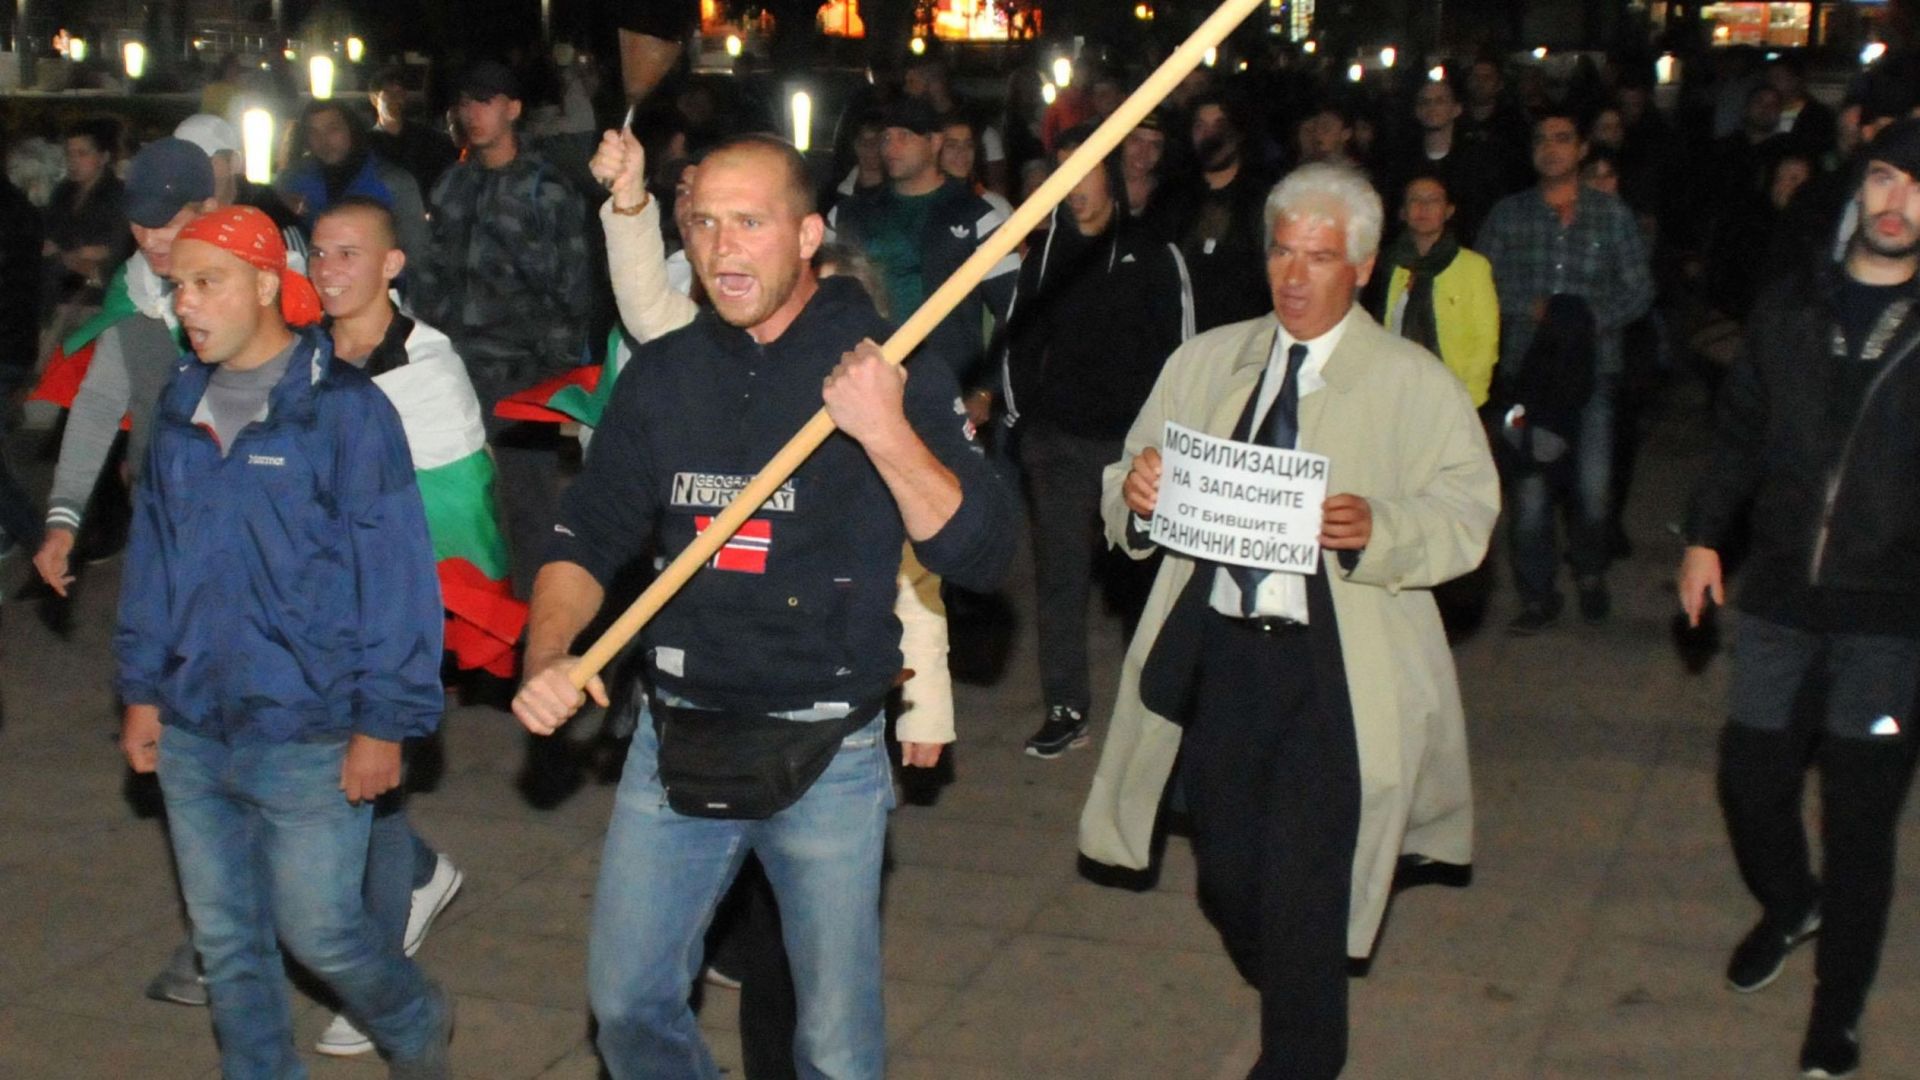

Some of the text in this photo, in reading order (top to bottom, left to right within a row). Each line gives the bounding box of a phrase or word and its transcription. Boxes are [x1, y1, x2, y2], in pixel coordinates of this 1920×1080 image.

[1166, 428, 1325, 480] МОБИЛИЗАЦИЯ
[674, 475, 790, 509] NORAY
[1173, 468, 1304, 508] НА ЗАПАСНИТЕ
[1179, 504, 1287, 534] ОТ БИВШИТЕ
[1154, 514, 1314, 566] ГРАНИЧНИ ВОЙСКИ
